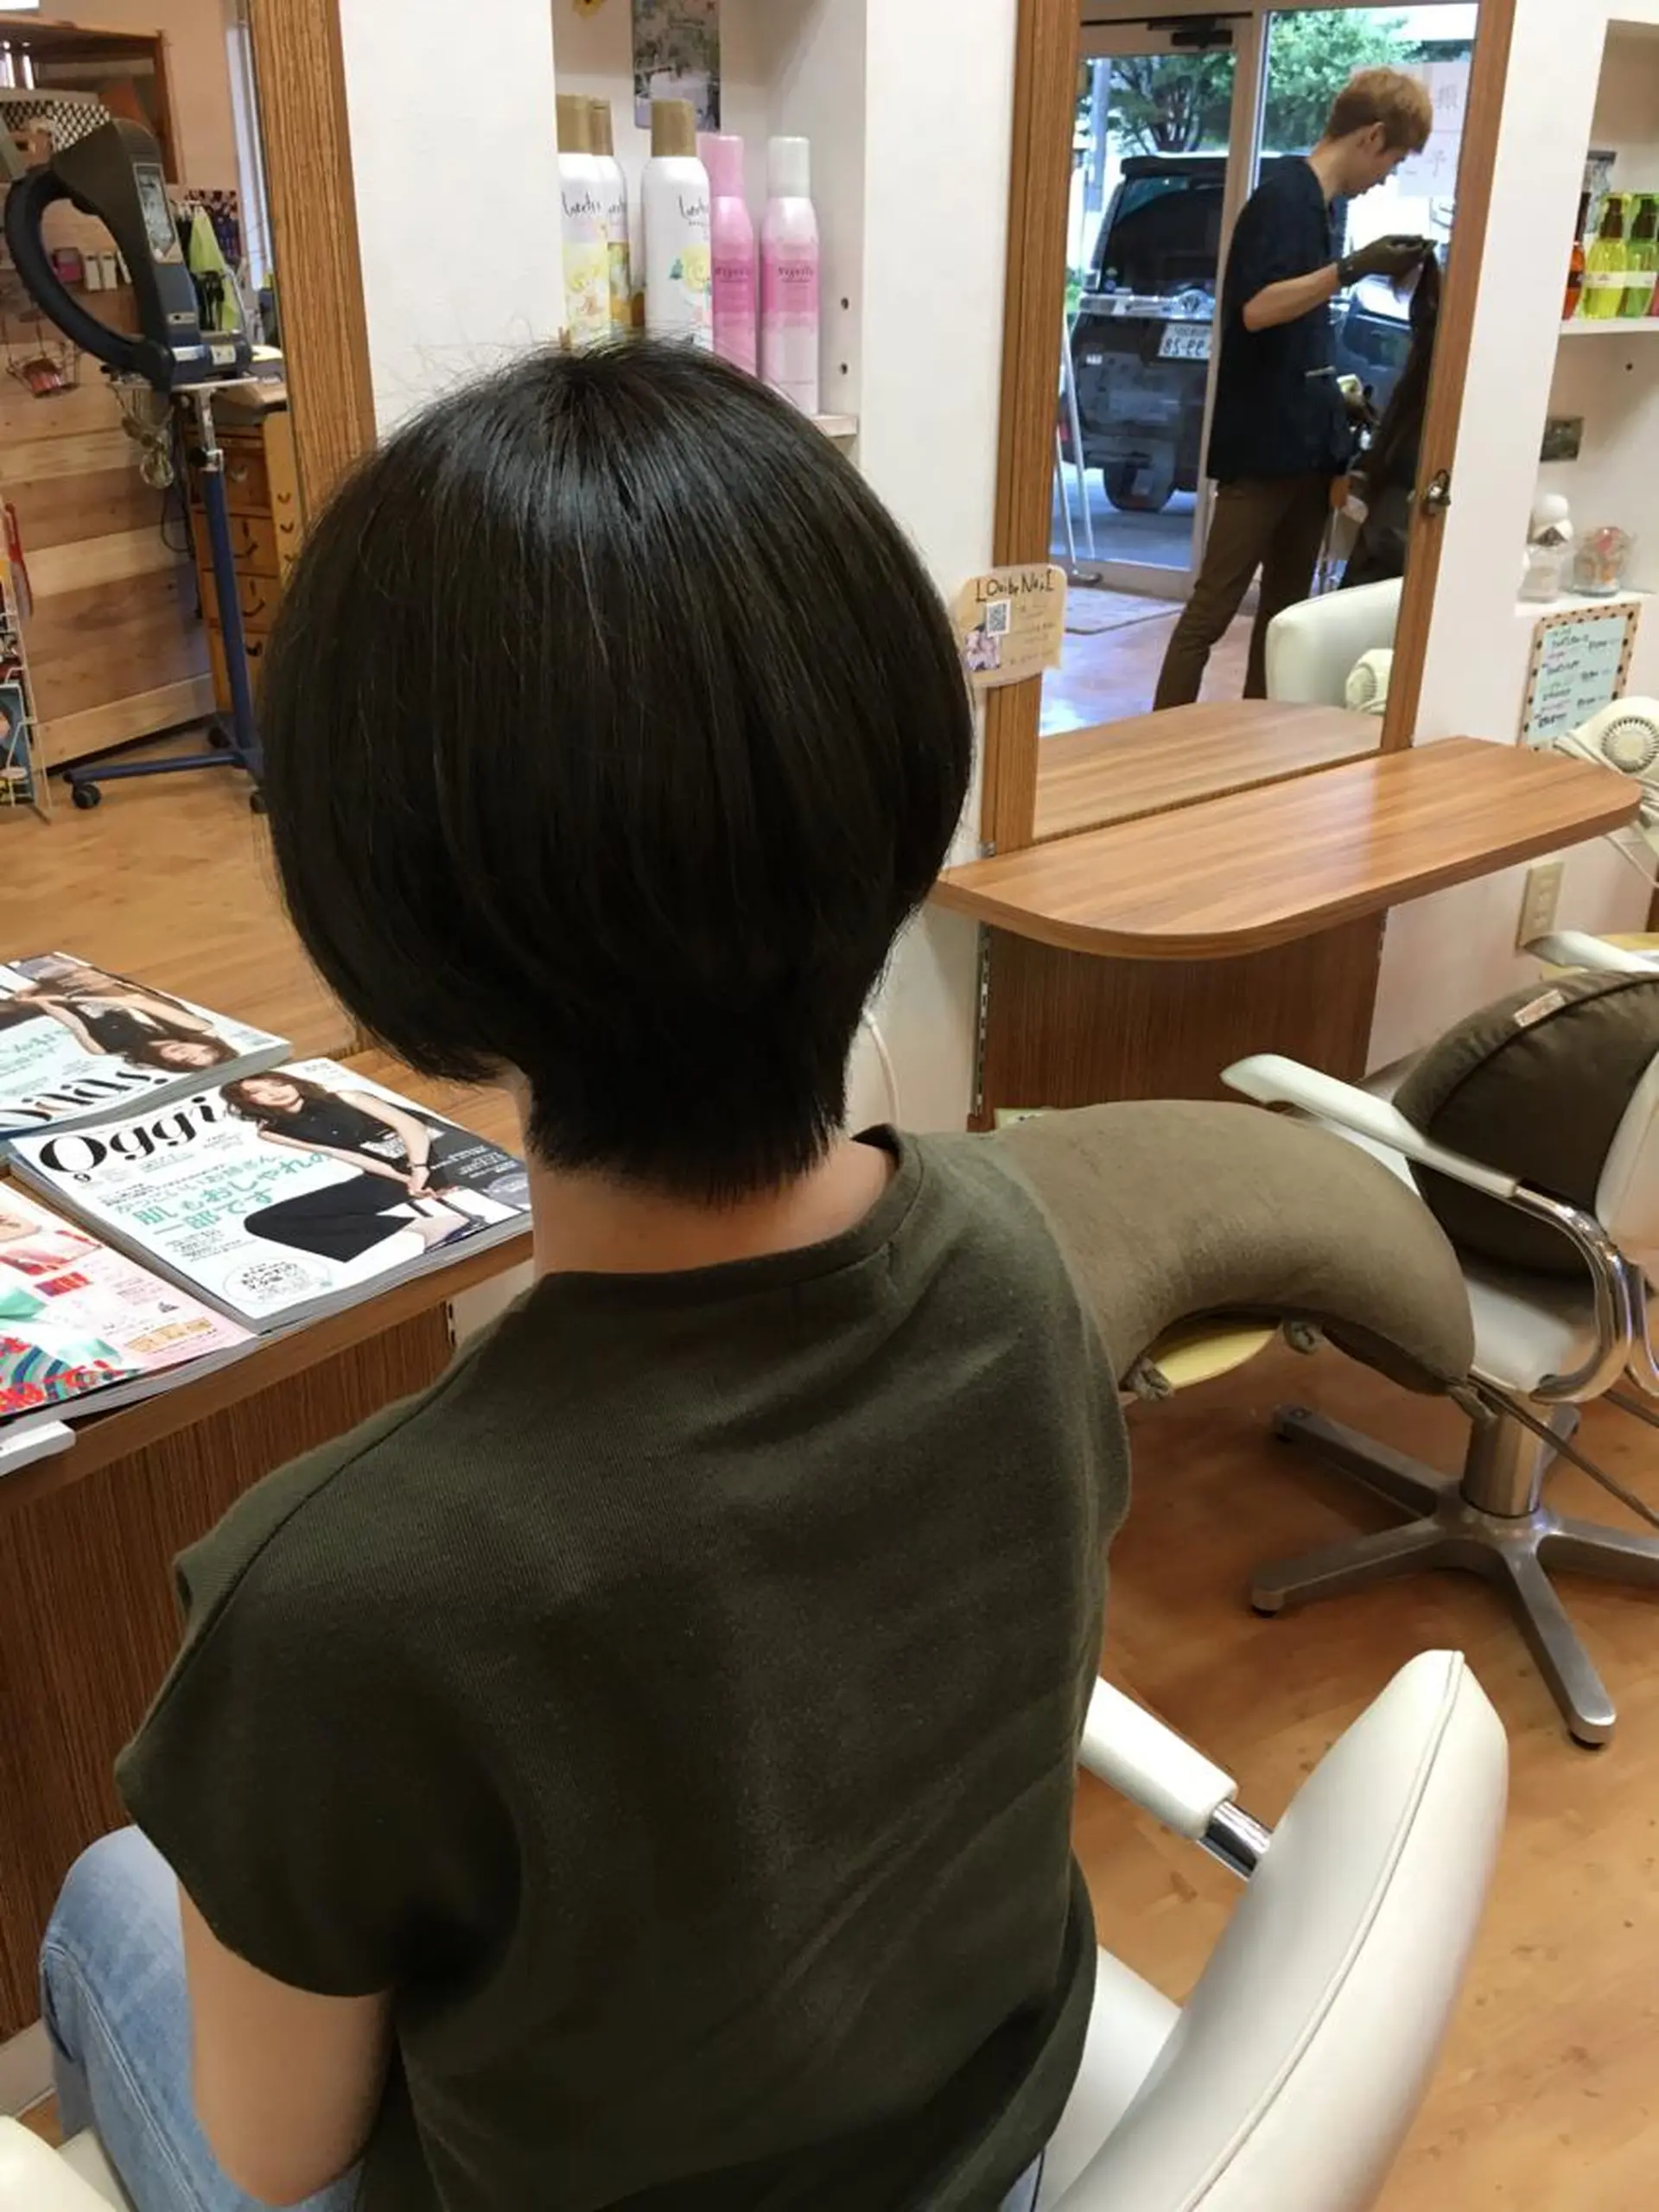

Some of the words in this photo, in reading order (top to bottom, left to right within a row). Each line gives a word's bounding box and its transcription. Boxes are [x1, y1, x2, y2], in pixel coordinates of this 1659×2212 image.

[39, 1096, 218, 1173] Oggi
[132, 1151, 332, 1226] 肌もおしゃれの
[153, 1187, 273, 1236] 一部です
